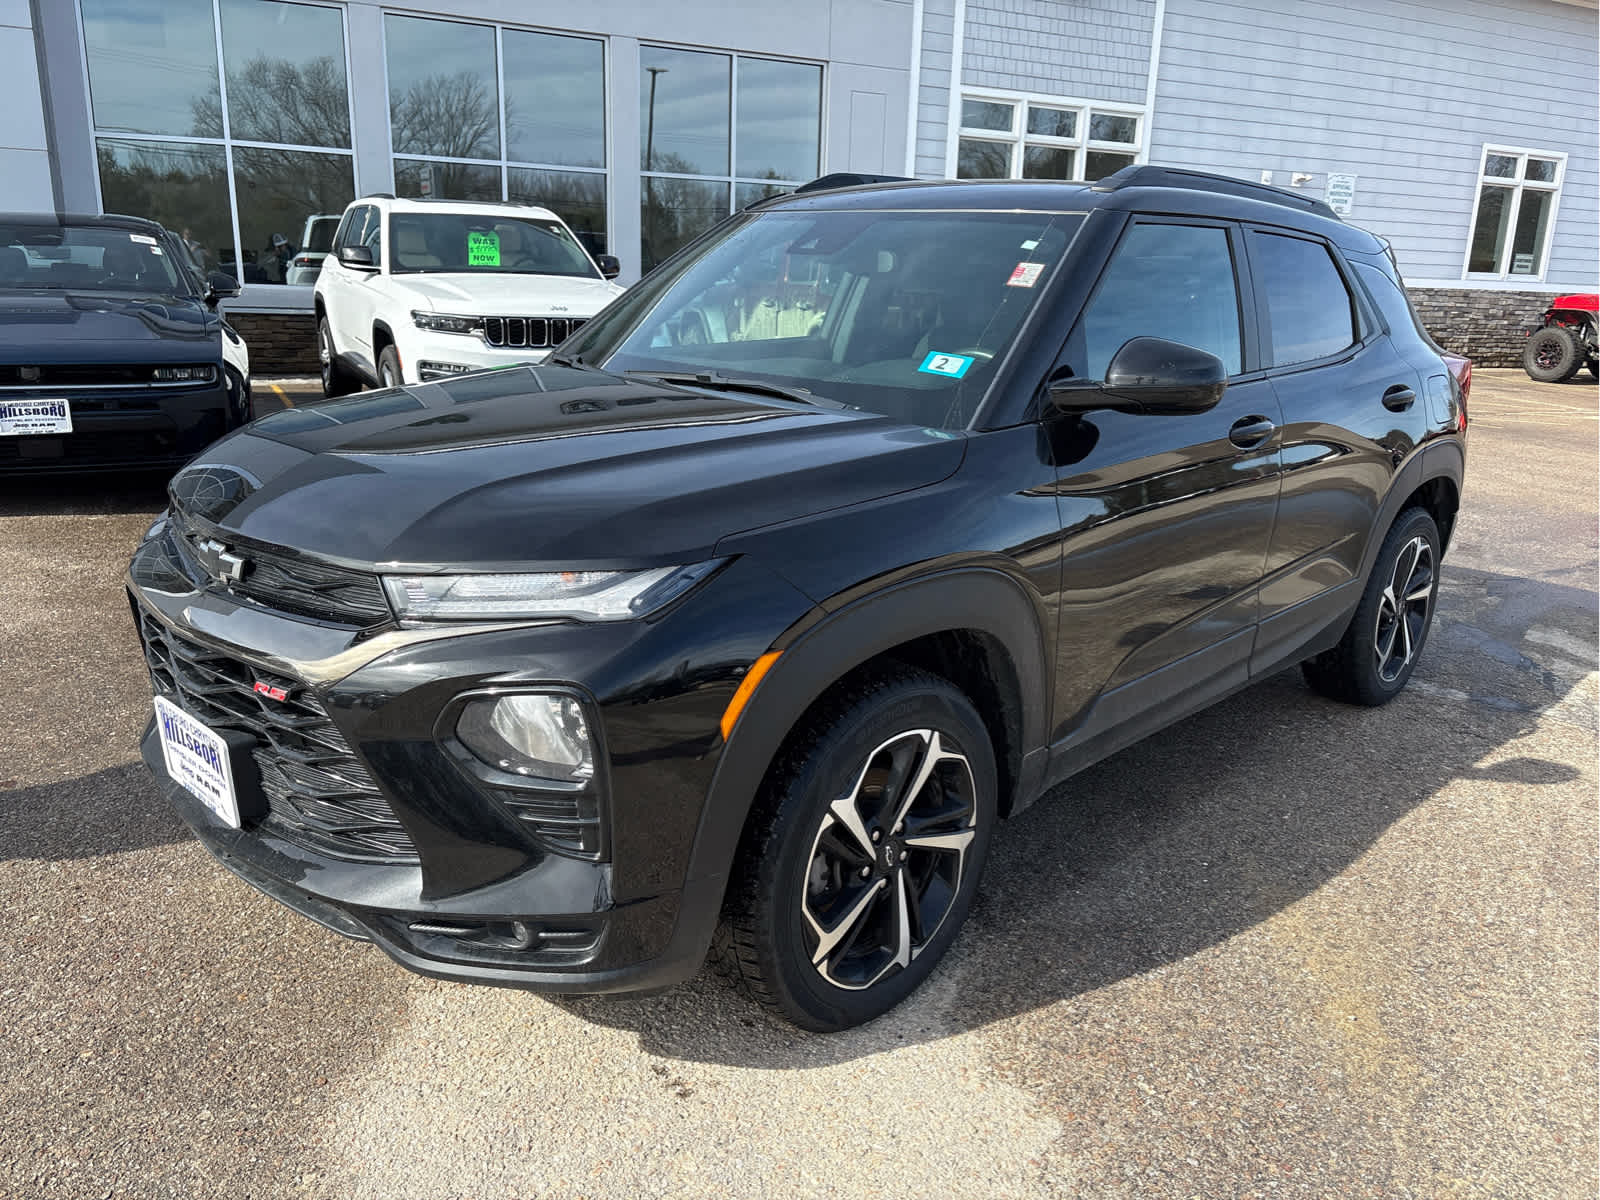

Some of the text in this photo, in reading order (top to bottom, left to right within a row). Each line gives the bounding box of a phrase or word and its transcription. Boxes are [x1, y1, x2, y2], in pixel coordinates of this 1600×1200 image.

[935, 357, 949, 370] 2
[0, 404, 66, 418] HILLSBORO
[253, 681, 288, 702] RS
